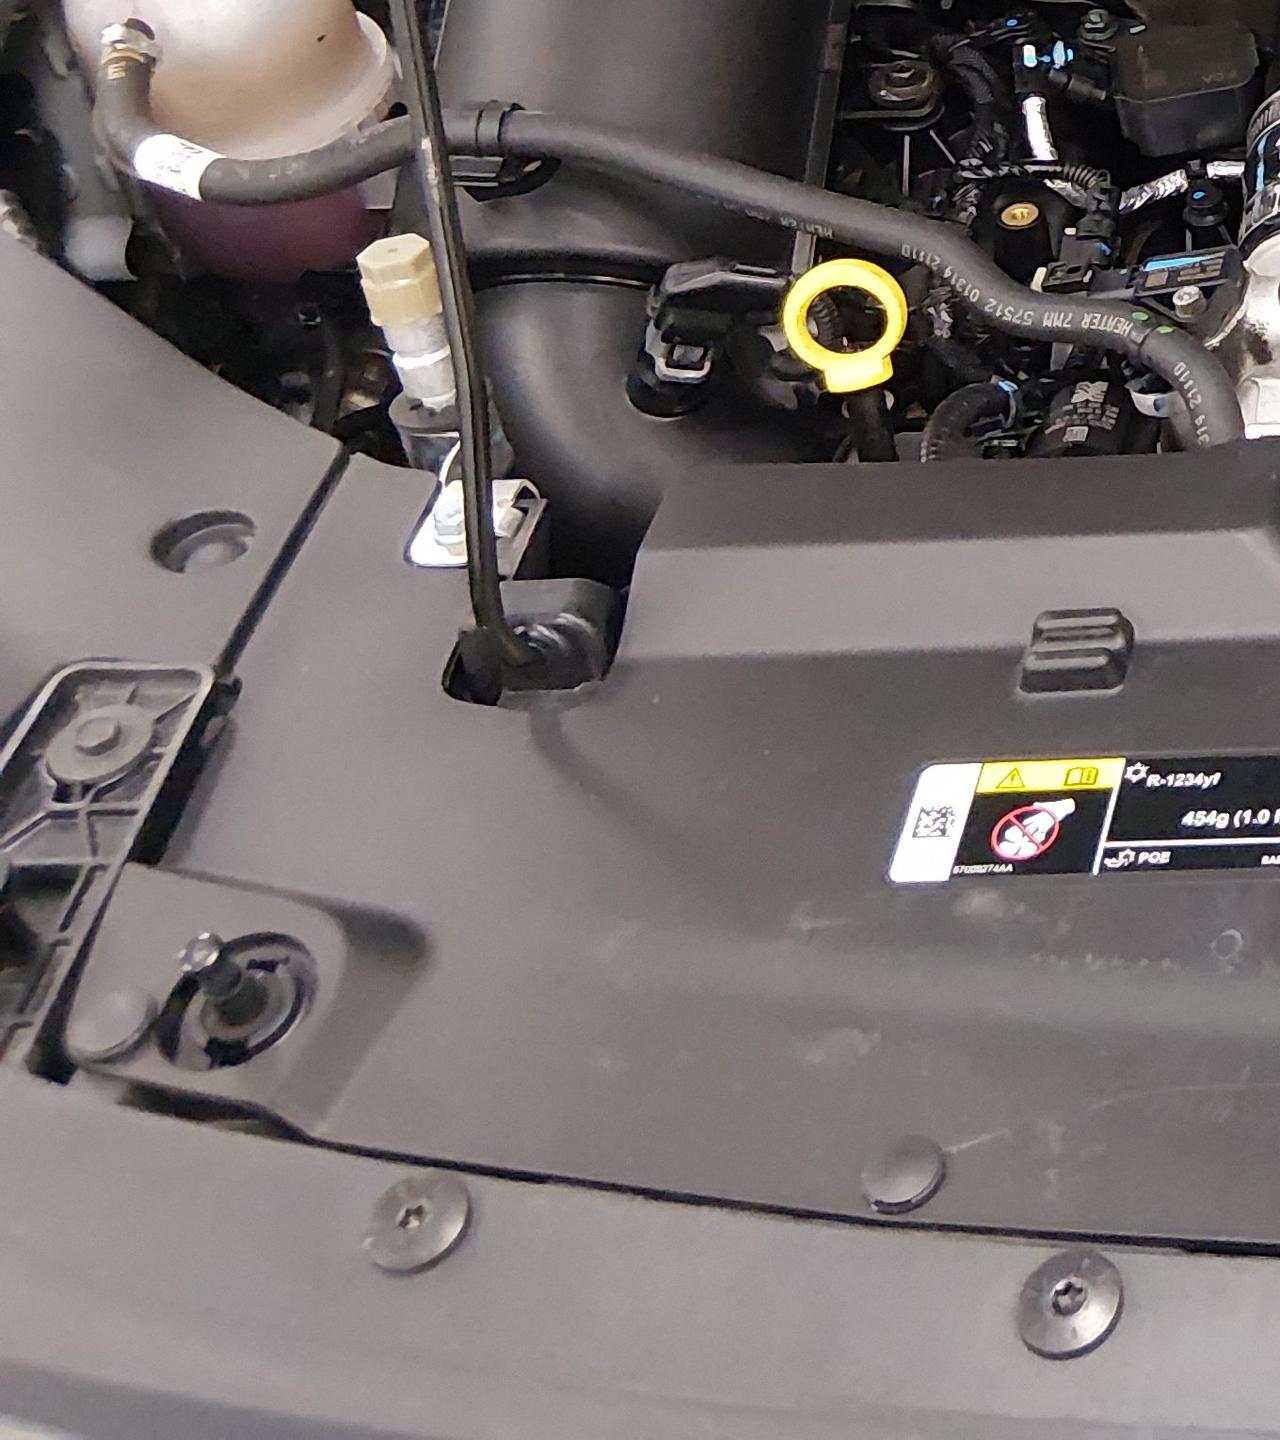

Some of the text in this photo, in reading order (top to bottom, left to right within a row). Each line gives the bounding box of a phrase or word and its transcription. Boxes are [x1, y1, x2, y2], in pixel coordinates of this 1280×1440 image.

[983, 297, 1034, 326] 57512
[1042, 311, 1072, 329] 7MM
[1081, 311, 1134, 338] HEATER
[1145, 771, 1222, 791] R-1234yf
[1180, 810, 1230, 830] 454g
[1233, 809, 1271, 828] (1.0
[1137, 850, 1172, 865] POE
